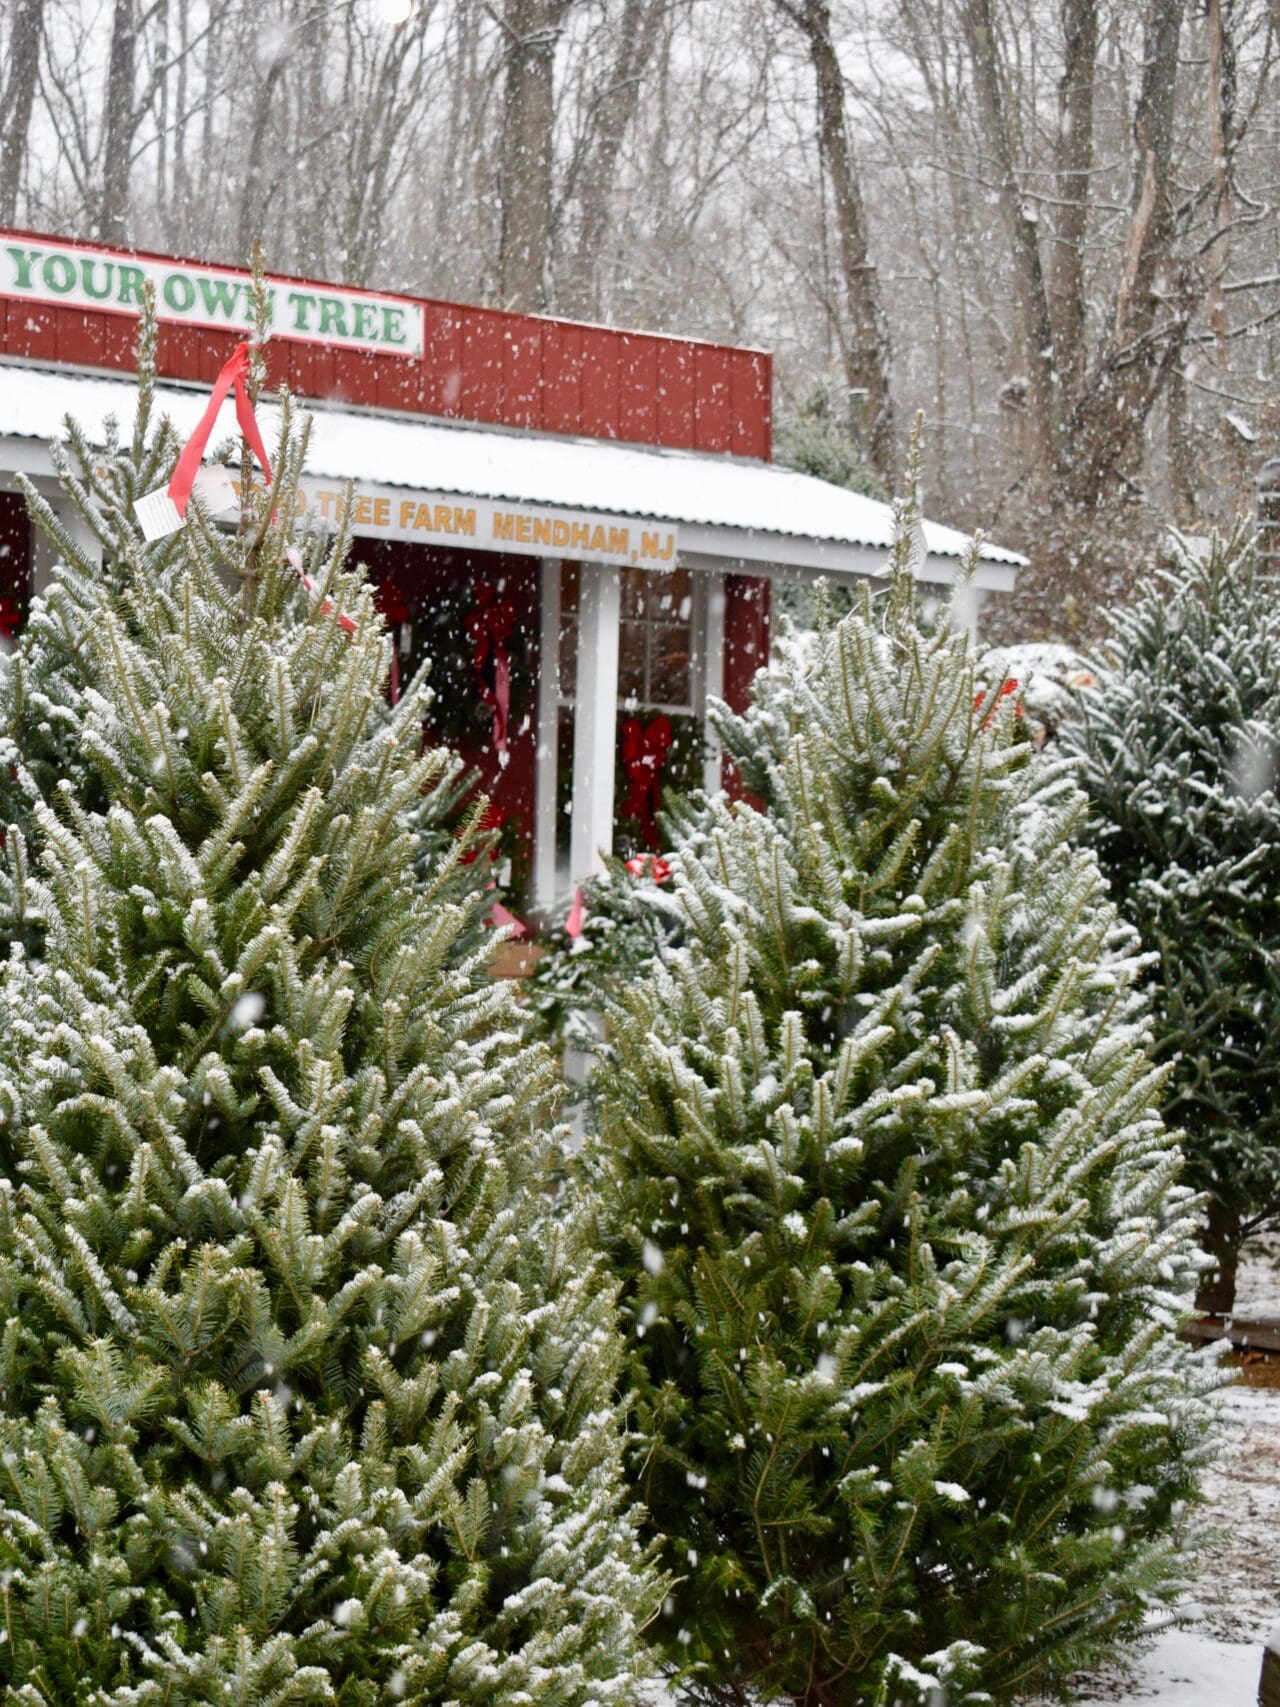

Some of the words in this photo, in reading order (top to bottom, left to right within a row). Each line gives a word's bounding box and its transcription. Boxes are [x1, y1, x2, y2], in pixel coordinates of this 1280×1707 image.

[7, 247, 145, 306] YOUR
[288, 293, 408, 345] TREE
[399, 501, 477, 537] FARM
